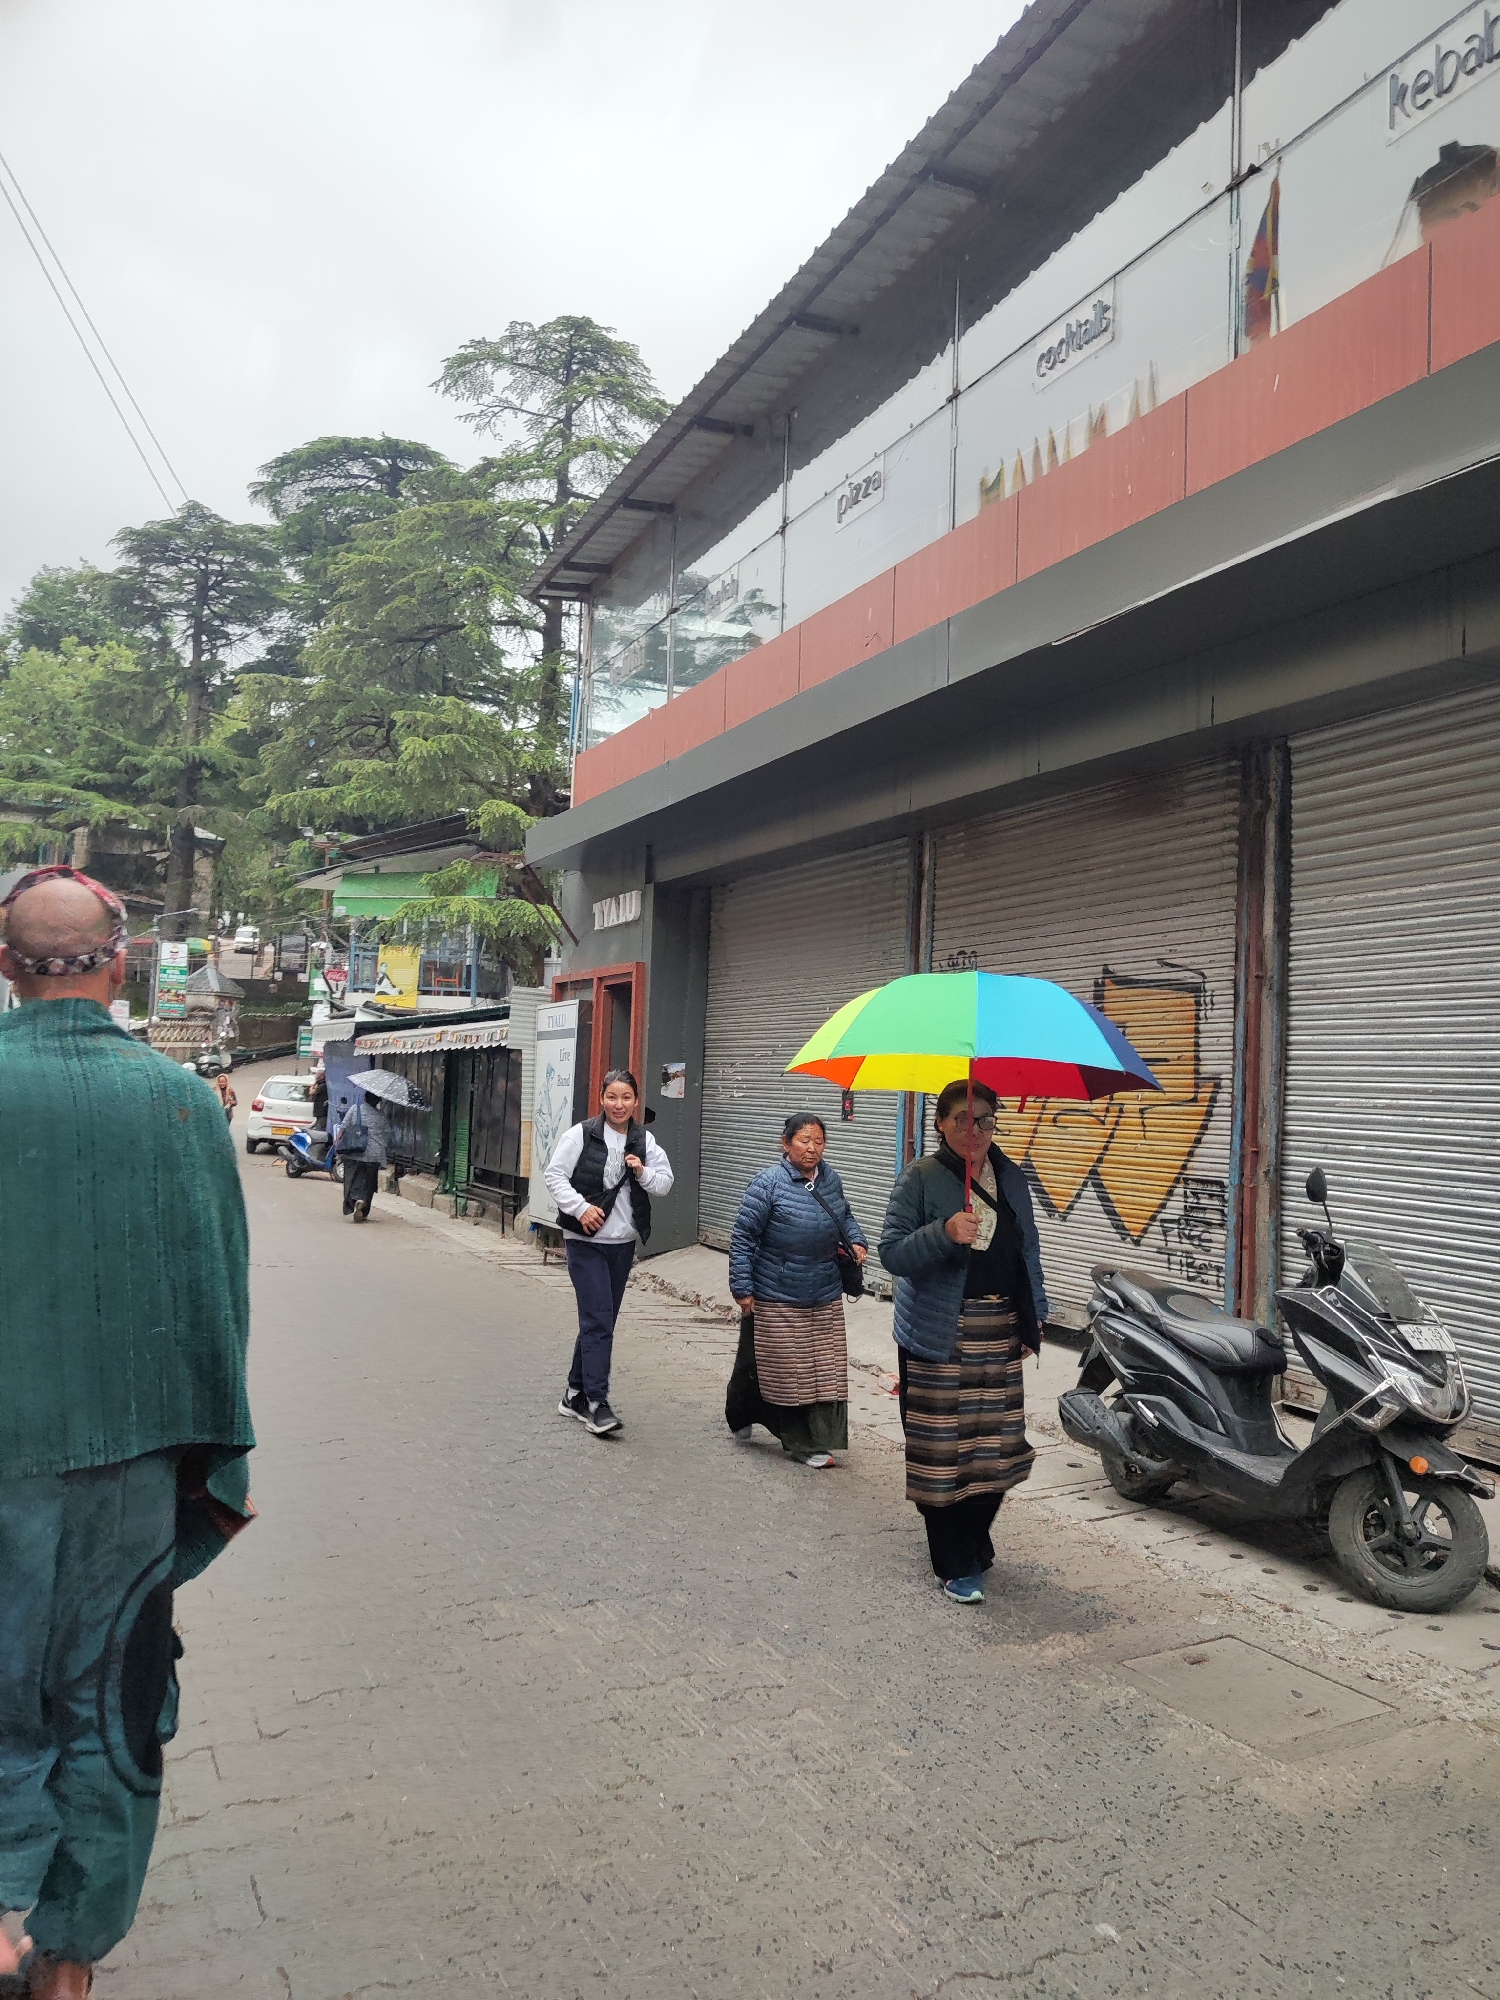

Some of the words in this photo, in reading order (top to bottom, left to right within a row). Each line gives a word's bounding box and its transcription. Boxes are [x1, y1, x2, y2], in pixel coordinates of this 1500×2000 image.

[837, 471, 882, 524] pizza
[592, 889, 643, 930] TYALU
[547, 1013, 567, 1029] TYALU
[559, 1047, 571, 1062] Live
[556, 1073, 571, 1087] Band
